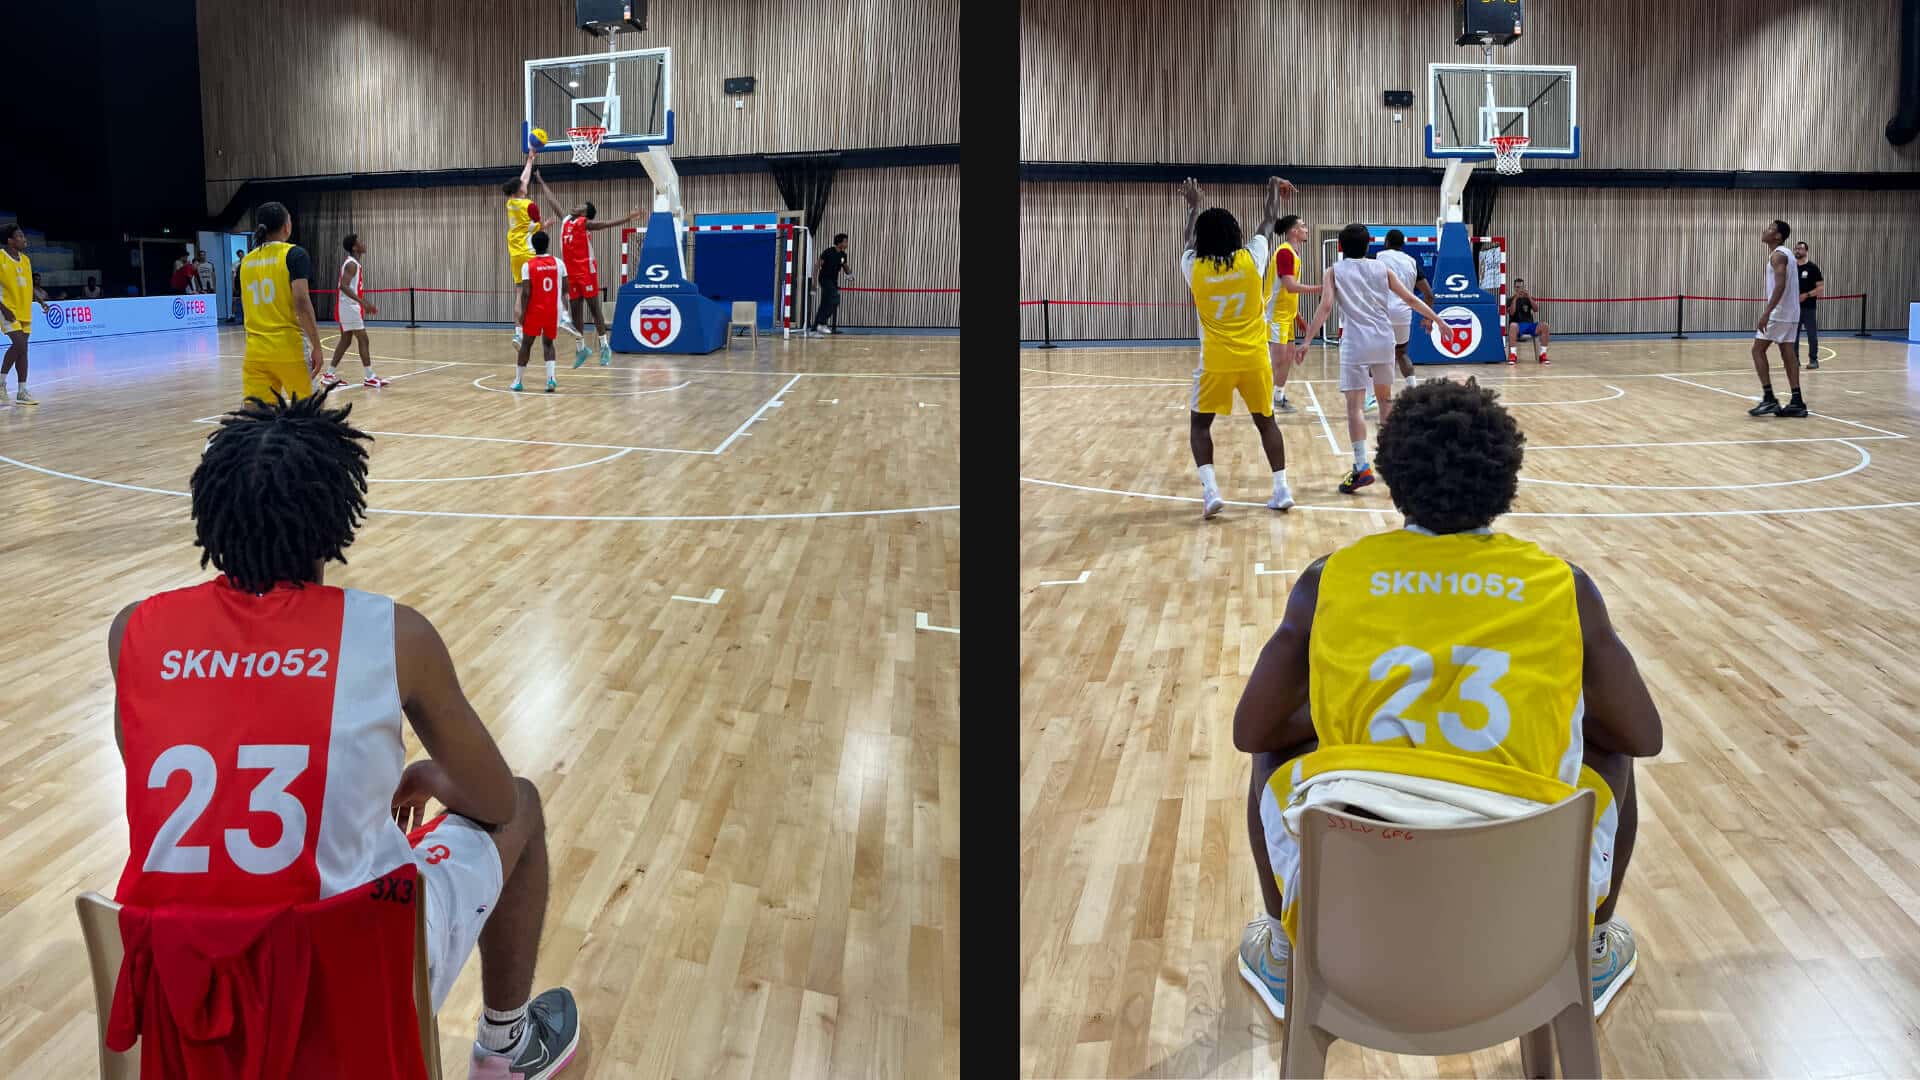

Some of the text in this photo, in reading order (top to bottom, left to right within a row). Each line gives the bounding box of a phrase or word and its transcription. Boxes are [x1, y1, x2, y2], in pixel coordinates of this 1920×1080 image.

[246, 278, 275, 305] 10
[543, 276, 553, 292] 0
[65, 306, 92, 323] FFBB
[186, 300, 206, 315] FFBB
[1208, 291, 1247, 320] 77
[1368, 570, 1526, 602] SKN1052
[160, 648, 329, 680] SKN1052
[1367, 644, 1512, 752] 23
[142, 743, 311, 876] 23
